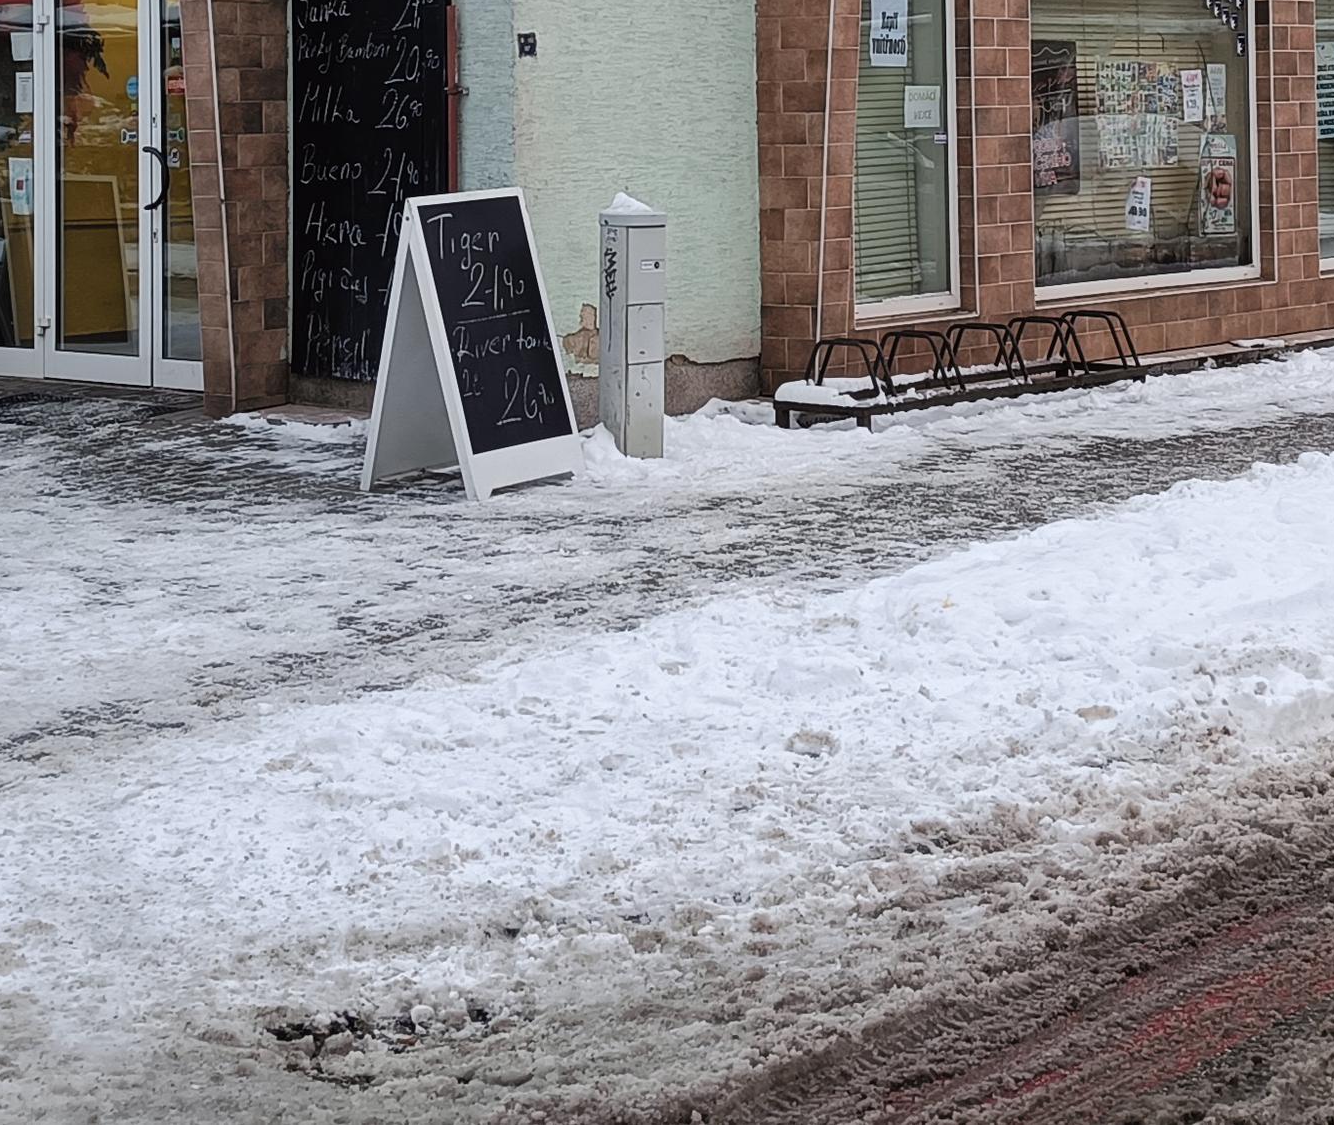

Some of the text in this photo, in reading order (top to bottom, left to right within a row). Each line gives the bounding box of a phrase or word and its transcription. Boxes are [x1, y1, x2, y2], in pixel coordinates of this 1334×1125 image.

[299, 82, 360, 123] Milka
[300, 143, 362, 184] Bueno
[427, 213, 499, 269] Tiger
[453, 325, 511, 363] River
